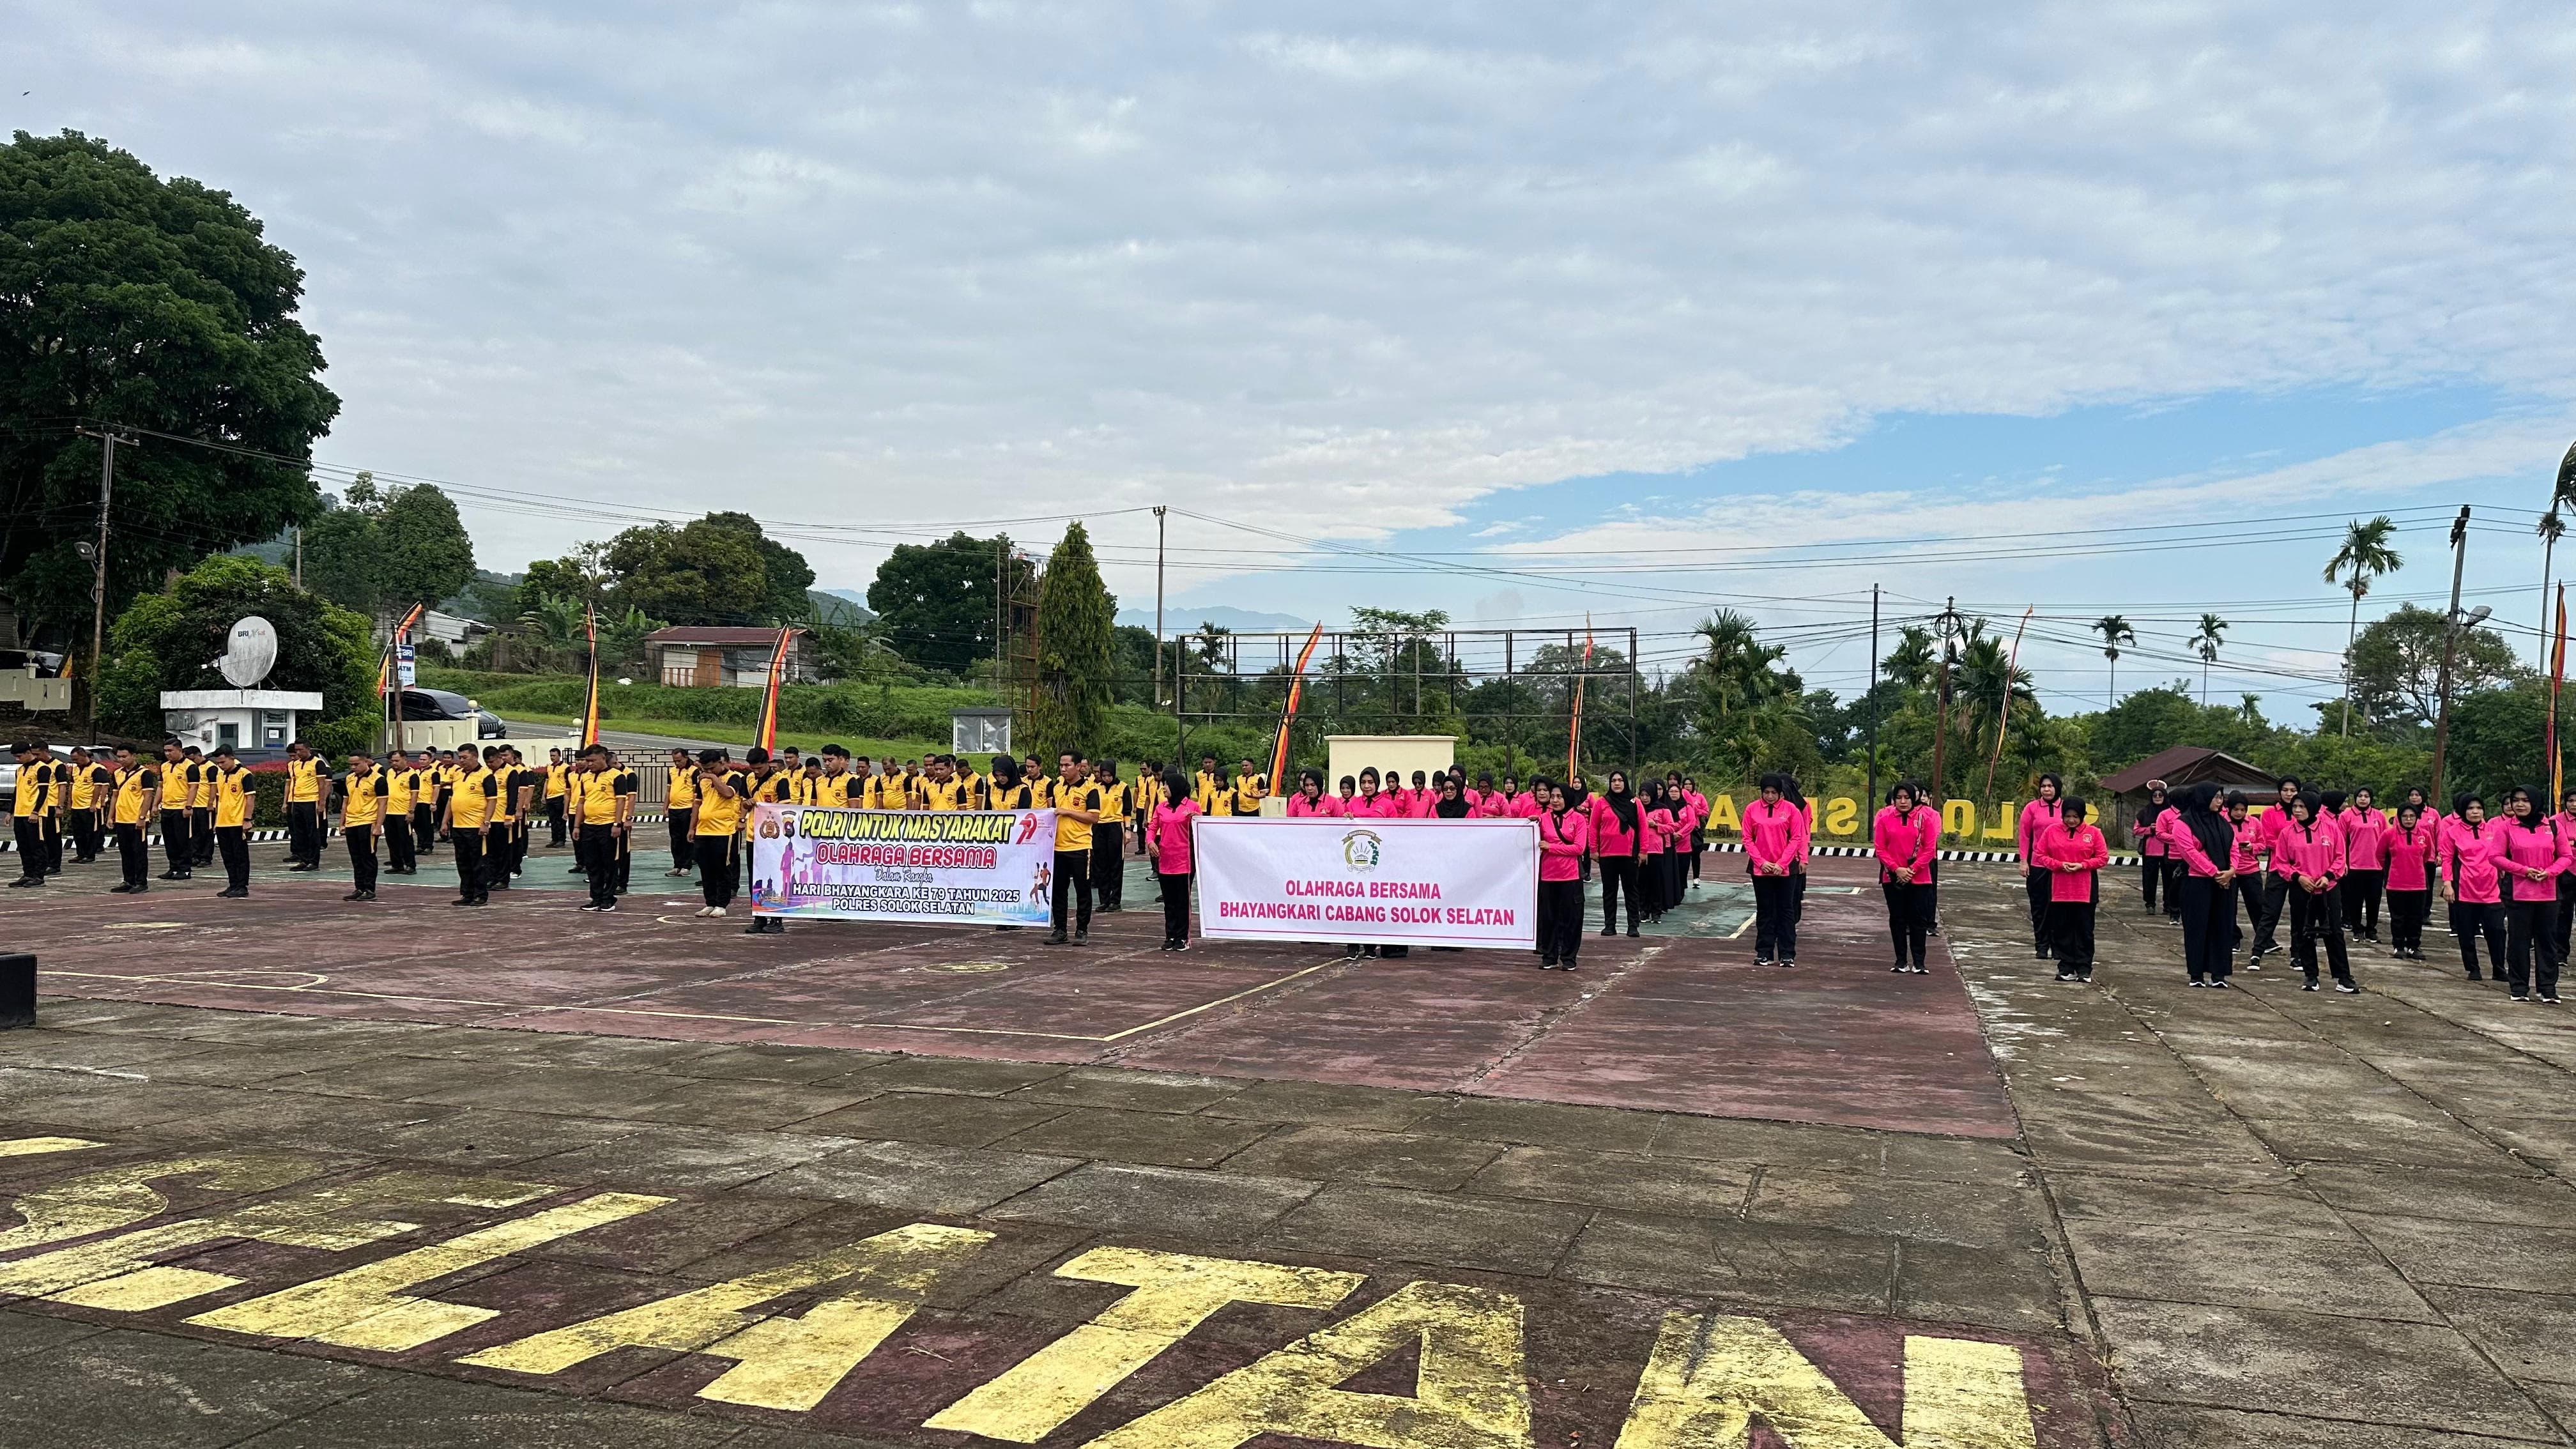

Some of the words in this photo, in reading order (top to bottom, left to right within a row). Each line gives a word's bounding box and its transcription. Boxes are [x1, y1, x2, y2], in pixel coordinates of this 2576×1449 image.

[800, 810, 848, 839] POLRI
[847, 813, 903, 841] UNTUK
[903, 814, 1016, 844] MASYARAKAT
[816, 842, 907, 867] OLAHRAGA
[908, 845, 997, 870] BERSAMA
[875, 865, 902, 882] Dalam
[902, 866, 933, 887] Rangka
[792, 884, 821, 896] HARI
[823, 885, 910, 899] BHAYANGKARA
[912, 887, 928, 900] KE
[931, 888, 946, 900] 79
[947, 888, 989, 901] TAHUN
[991, 890, 1020, 903] 2025
[1285, 880, 1365, 897] OLAHRAGA
[1370, 882, 1441, 899] BERSAMA
[832, 898, 878, 912] POLRES
[880, 900, 920, 913] SOLOK
[922, 901, 975, 915] SELATAN
[1220, 901, 1320, 920] BHAYANGKARI
[1325, 905, 1386, 922] CABANG
[1391, 907, 1442, 924] SOLOK
[1446, 908, 1514, 925] SELATAN
